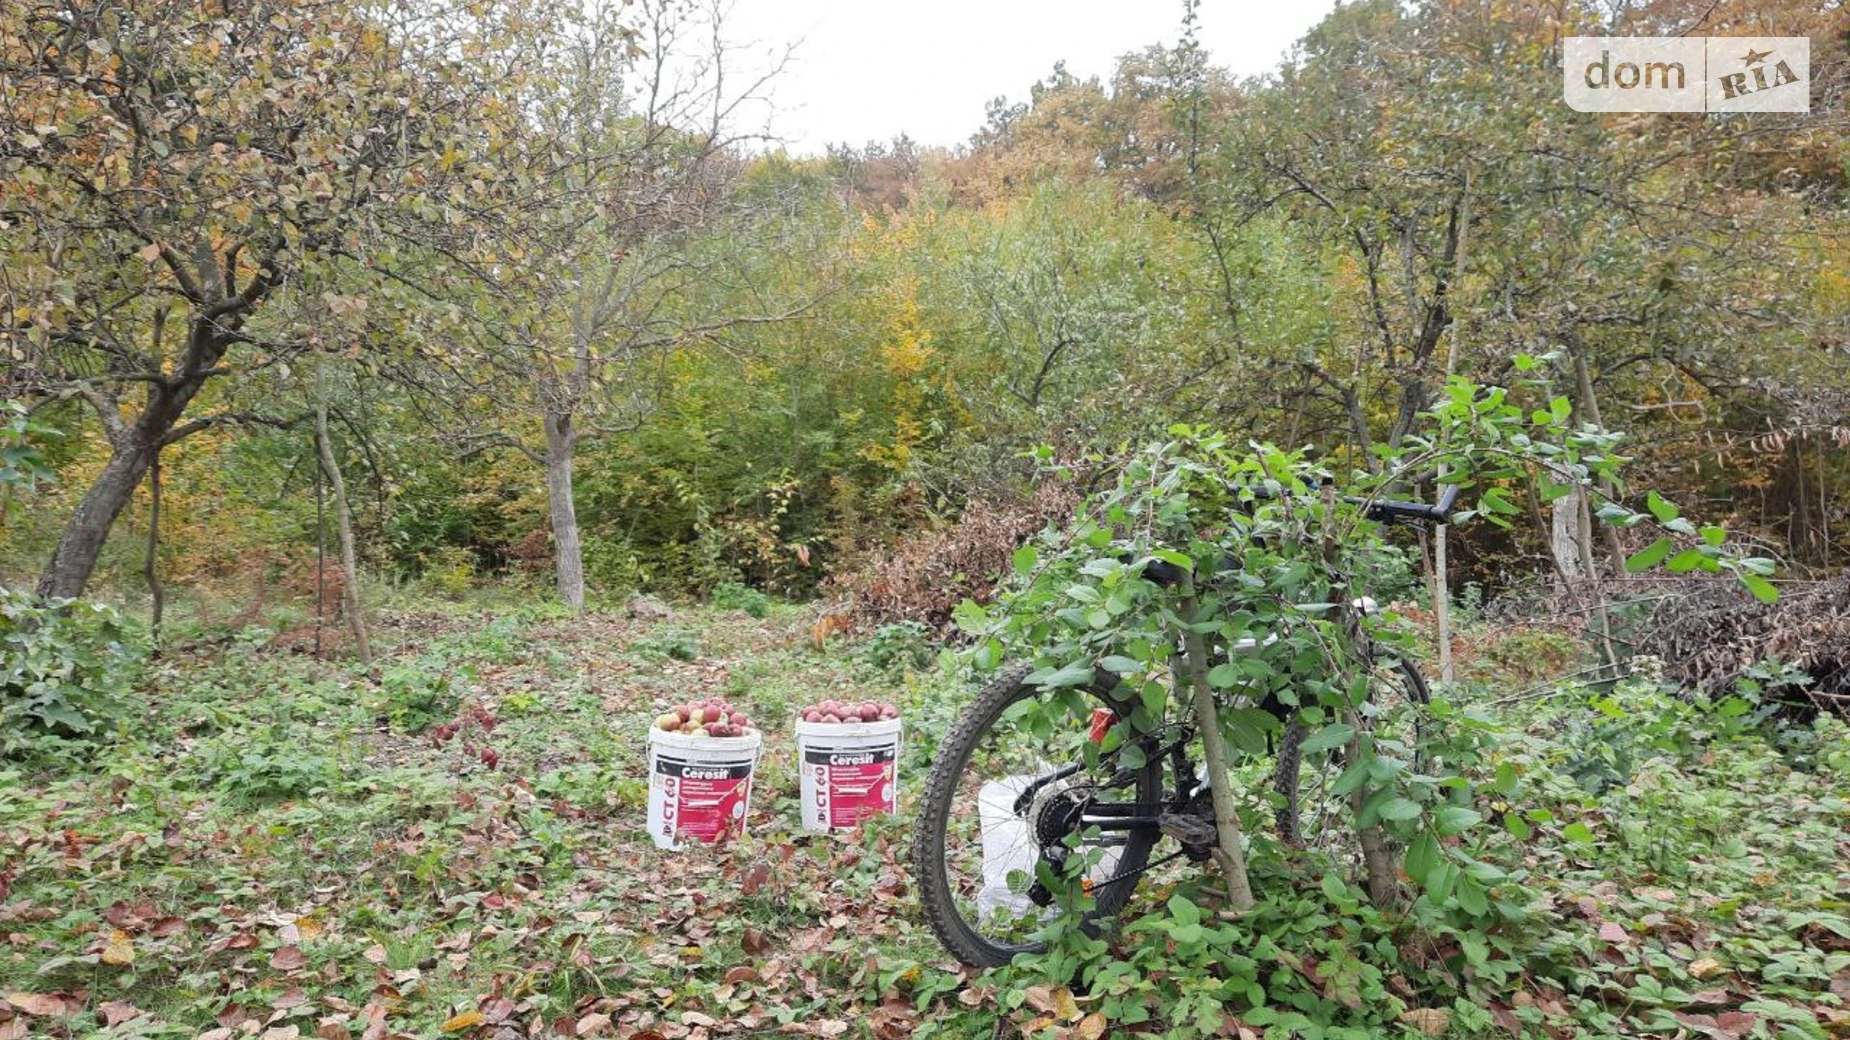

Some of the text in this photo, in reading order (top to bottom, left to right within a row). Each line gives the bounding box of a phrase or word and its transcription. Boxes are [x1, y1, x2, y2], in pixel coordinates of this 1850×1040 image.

[830, 753, 875, 765] Ceresit
[681, 767, 730, 780] Ceresit
[663, 778, 676, 820] CT 60
[815, 767, 827, 807] CT 60
